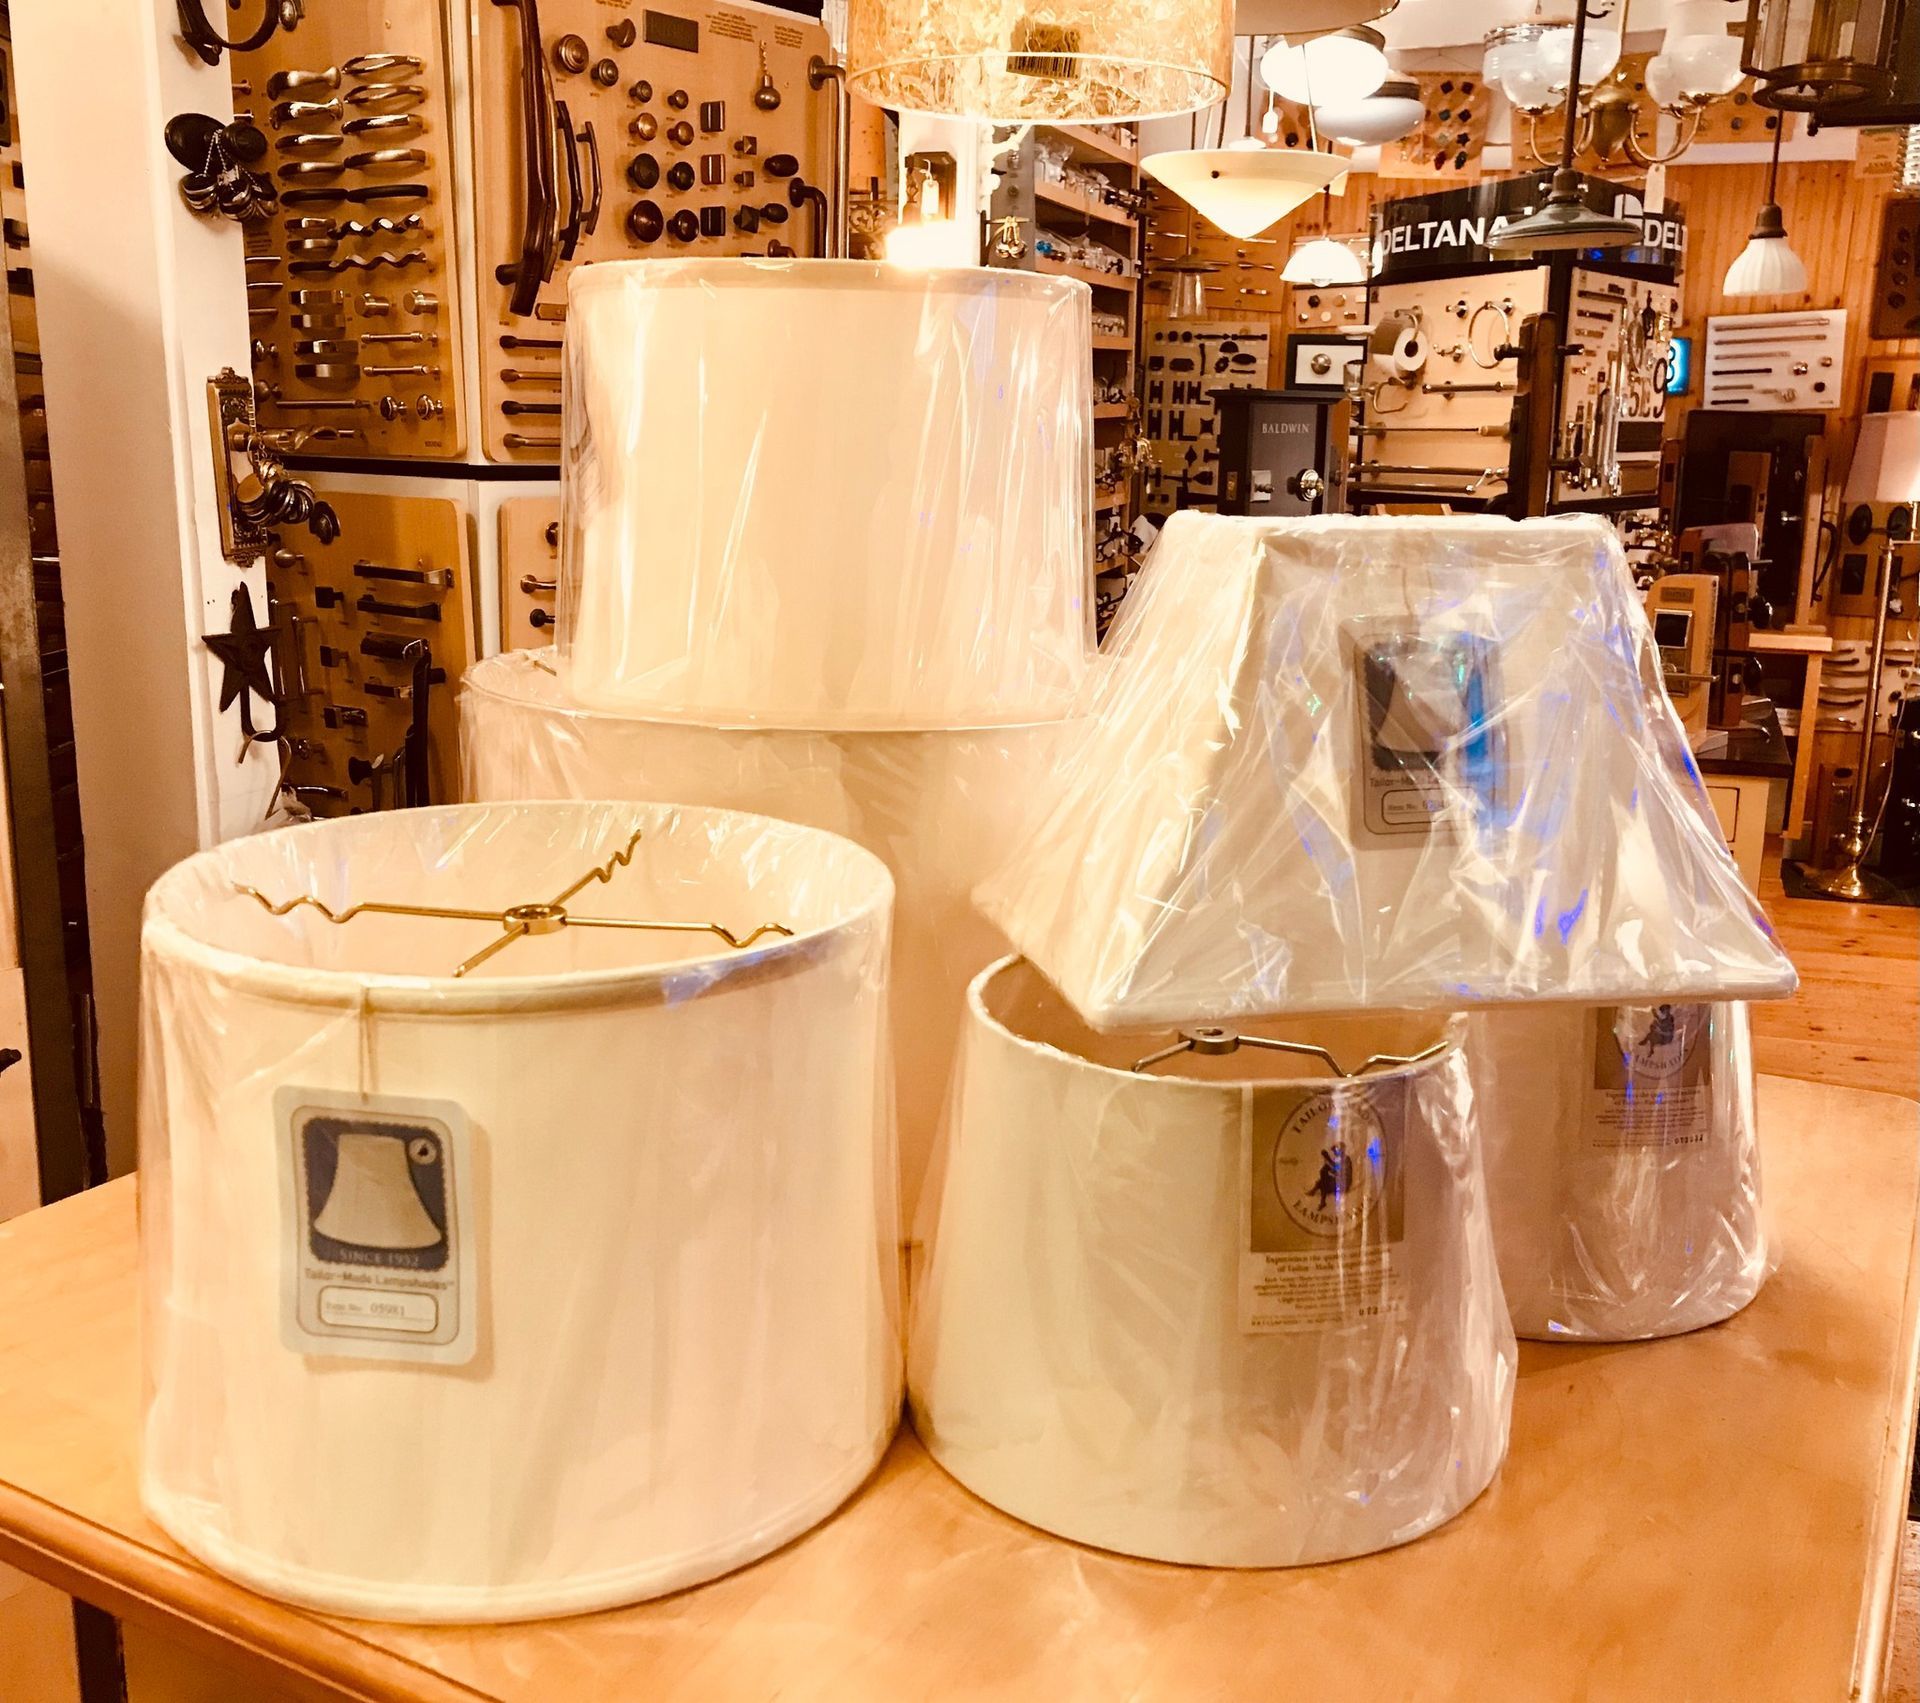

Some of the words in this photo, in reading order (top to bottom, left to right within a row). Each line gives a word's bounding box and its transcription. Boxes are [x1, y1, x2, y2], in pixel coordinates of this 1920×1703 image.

[1382, 216, 1509, 256] DELTANA
[1262, 423, 1311, 434] BALDWIN
[340, 1248, 381, 1264] SINCE
